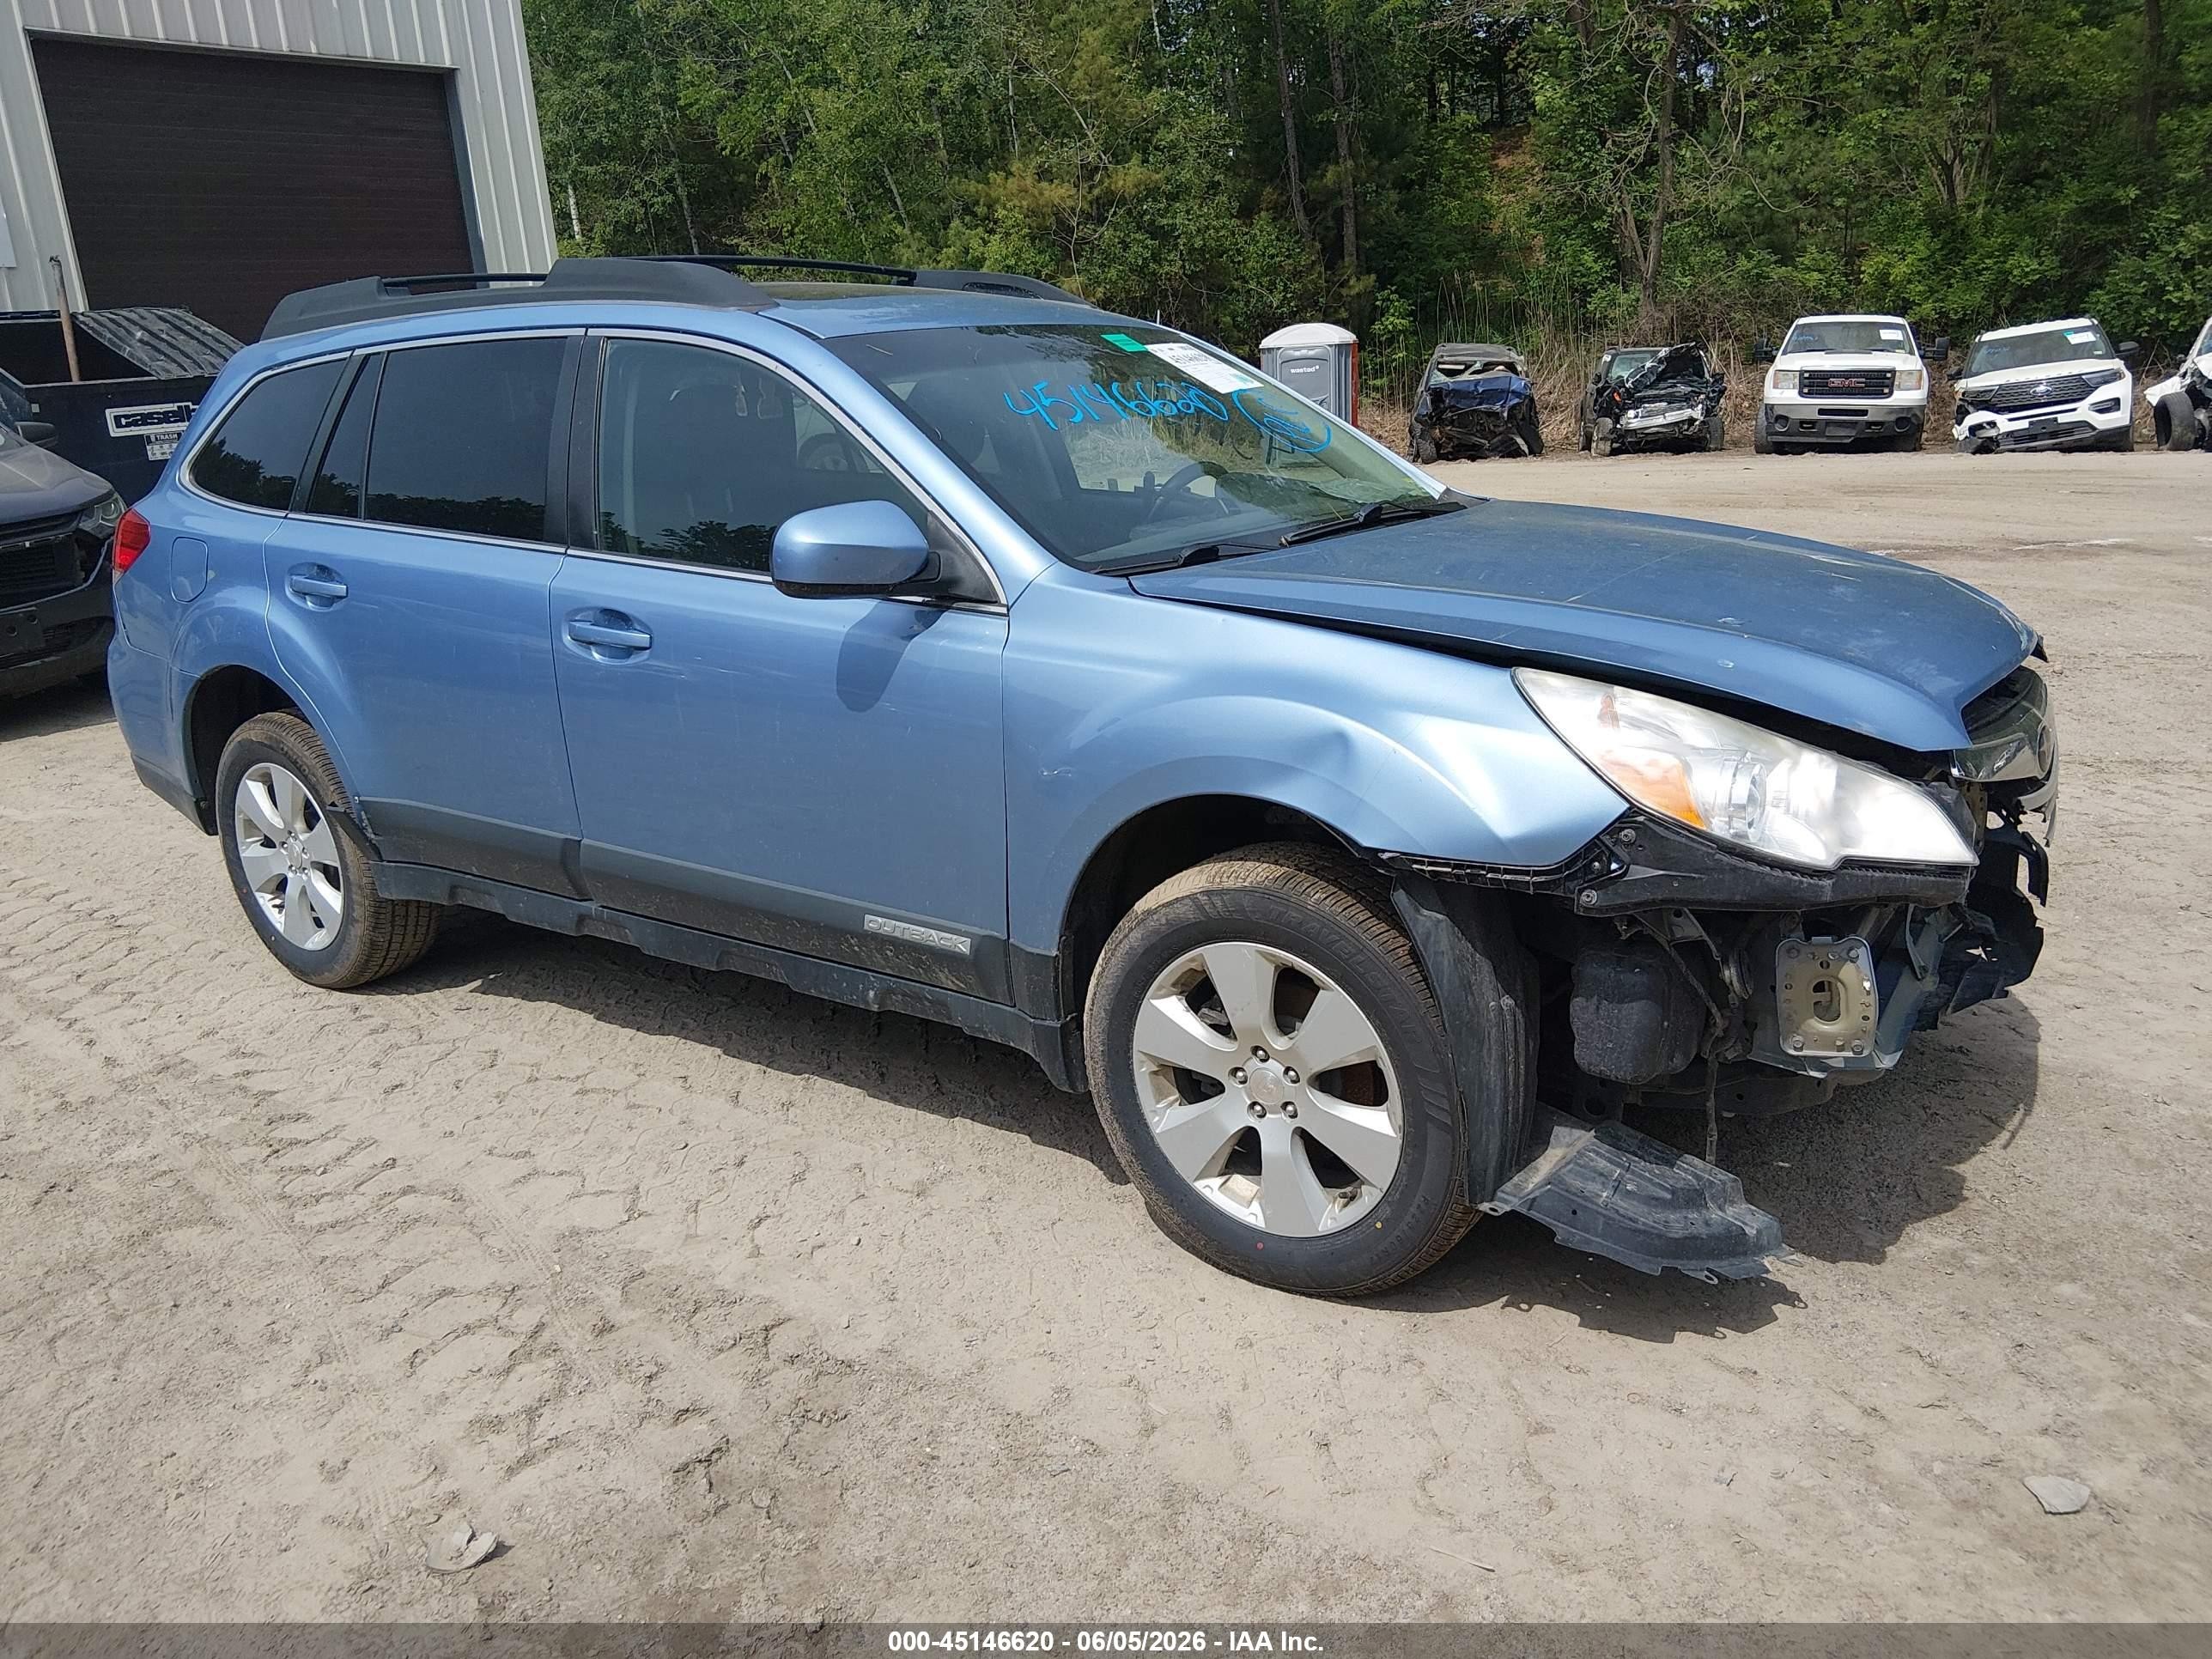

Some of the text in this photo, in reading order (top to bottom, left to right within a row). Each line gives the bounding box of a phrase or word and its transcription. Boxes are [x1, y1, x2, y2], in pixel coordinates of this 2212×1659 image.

[1827, 378, 1866, 388] GMC
[155, 433, 178, 441] TRASH
[866, 917, 969, 953] OUTBACK
